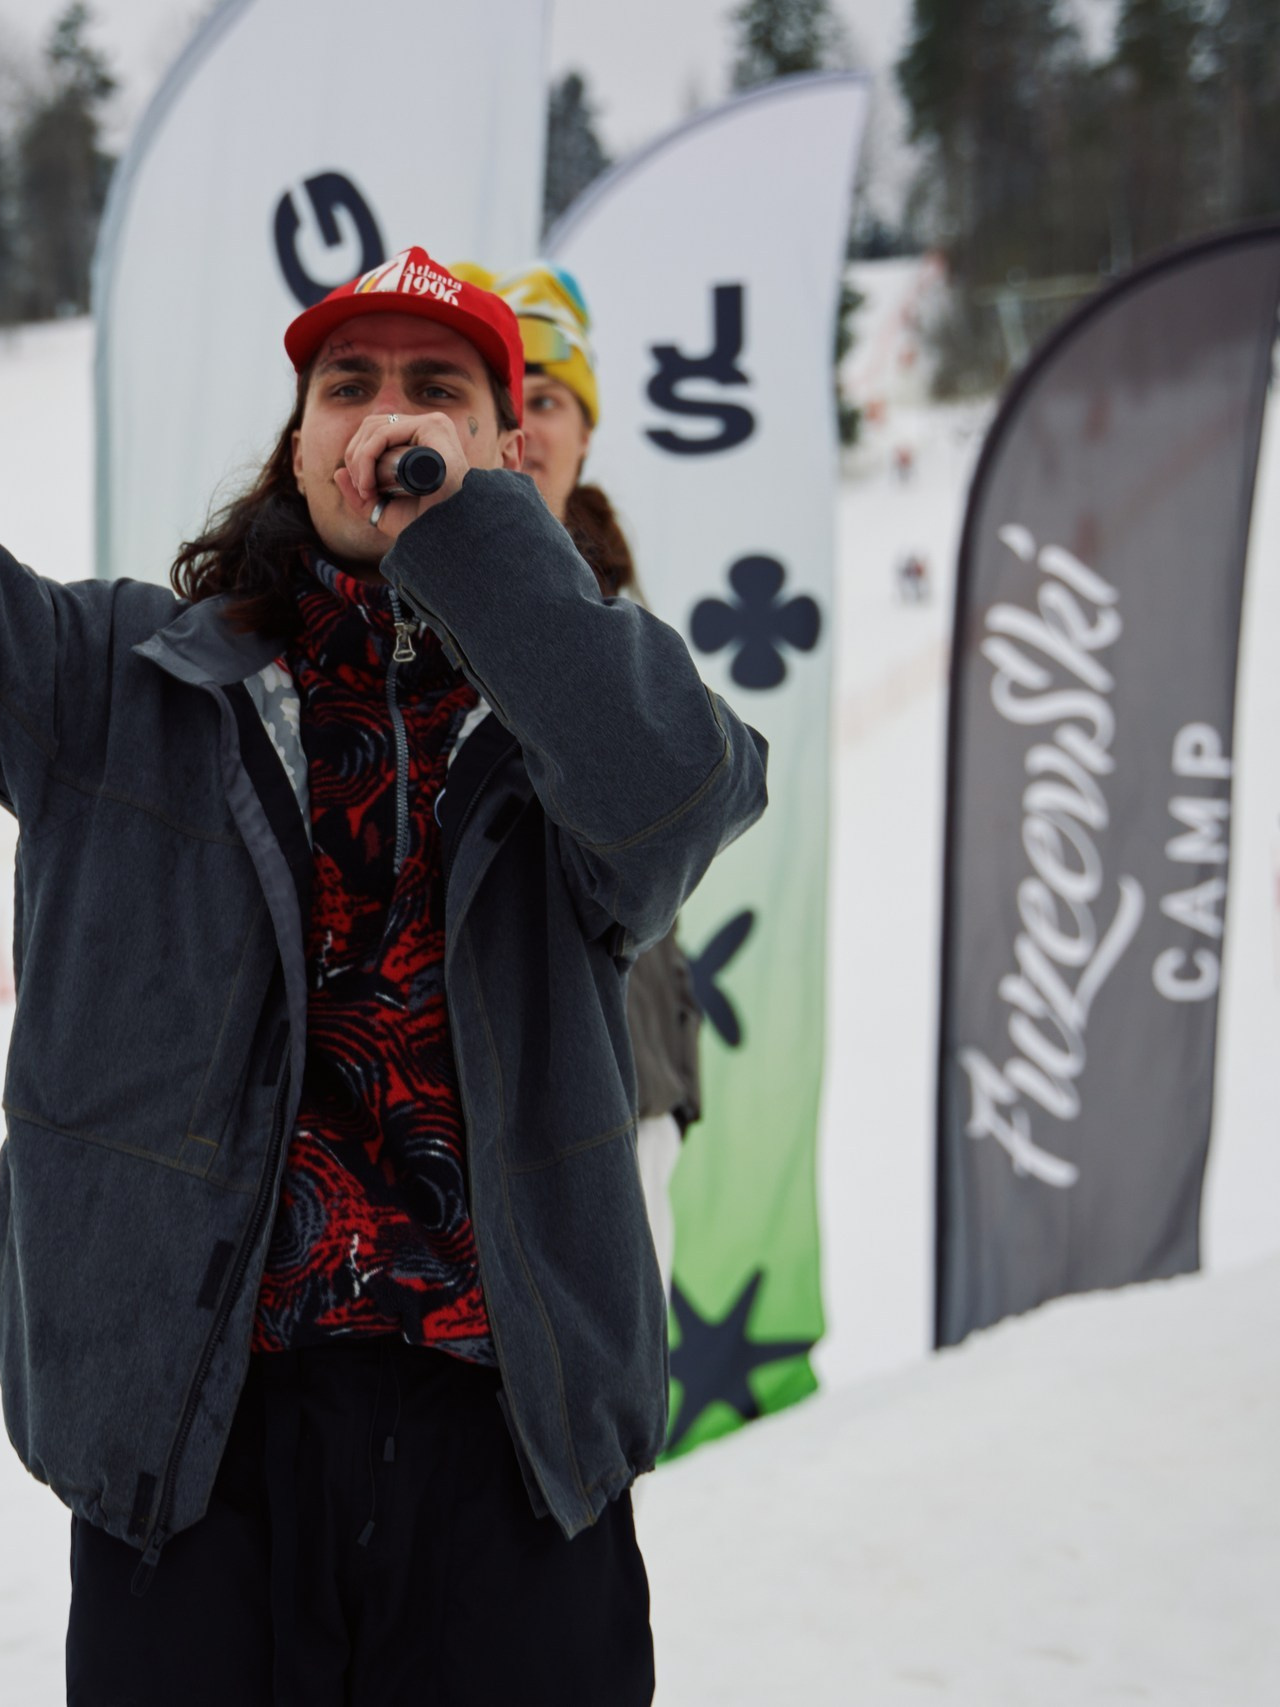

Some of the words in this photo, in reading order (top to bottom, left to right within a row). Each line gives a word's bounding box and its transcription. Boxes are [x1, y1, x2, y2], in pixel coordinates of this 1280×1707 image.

[401, 273, 459, 307] 1996
[402, 261, 463, 292] Atlanta
[1152, 720, 1233, 1002] CAMP
